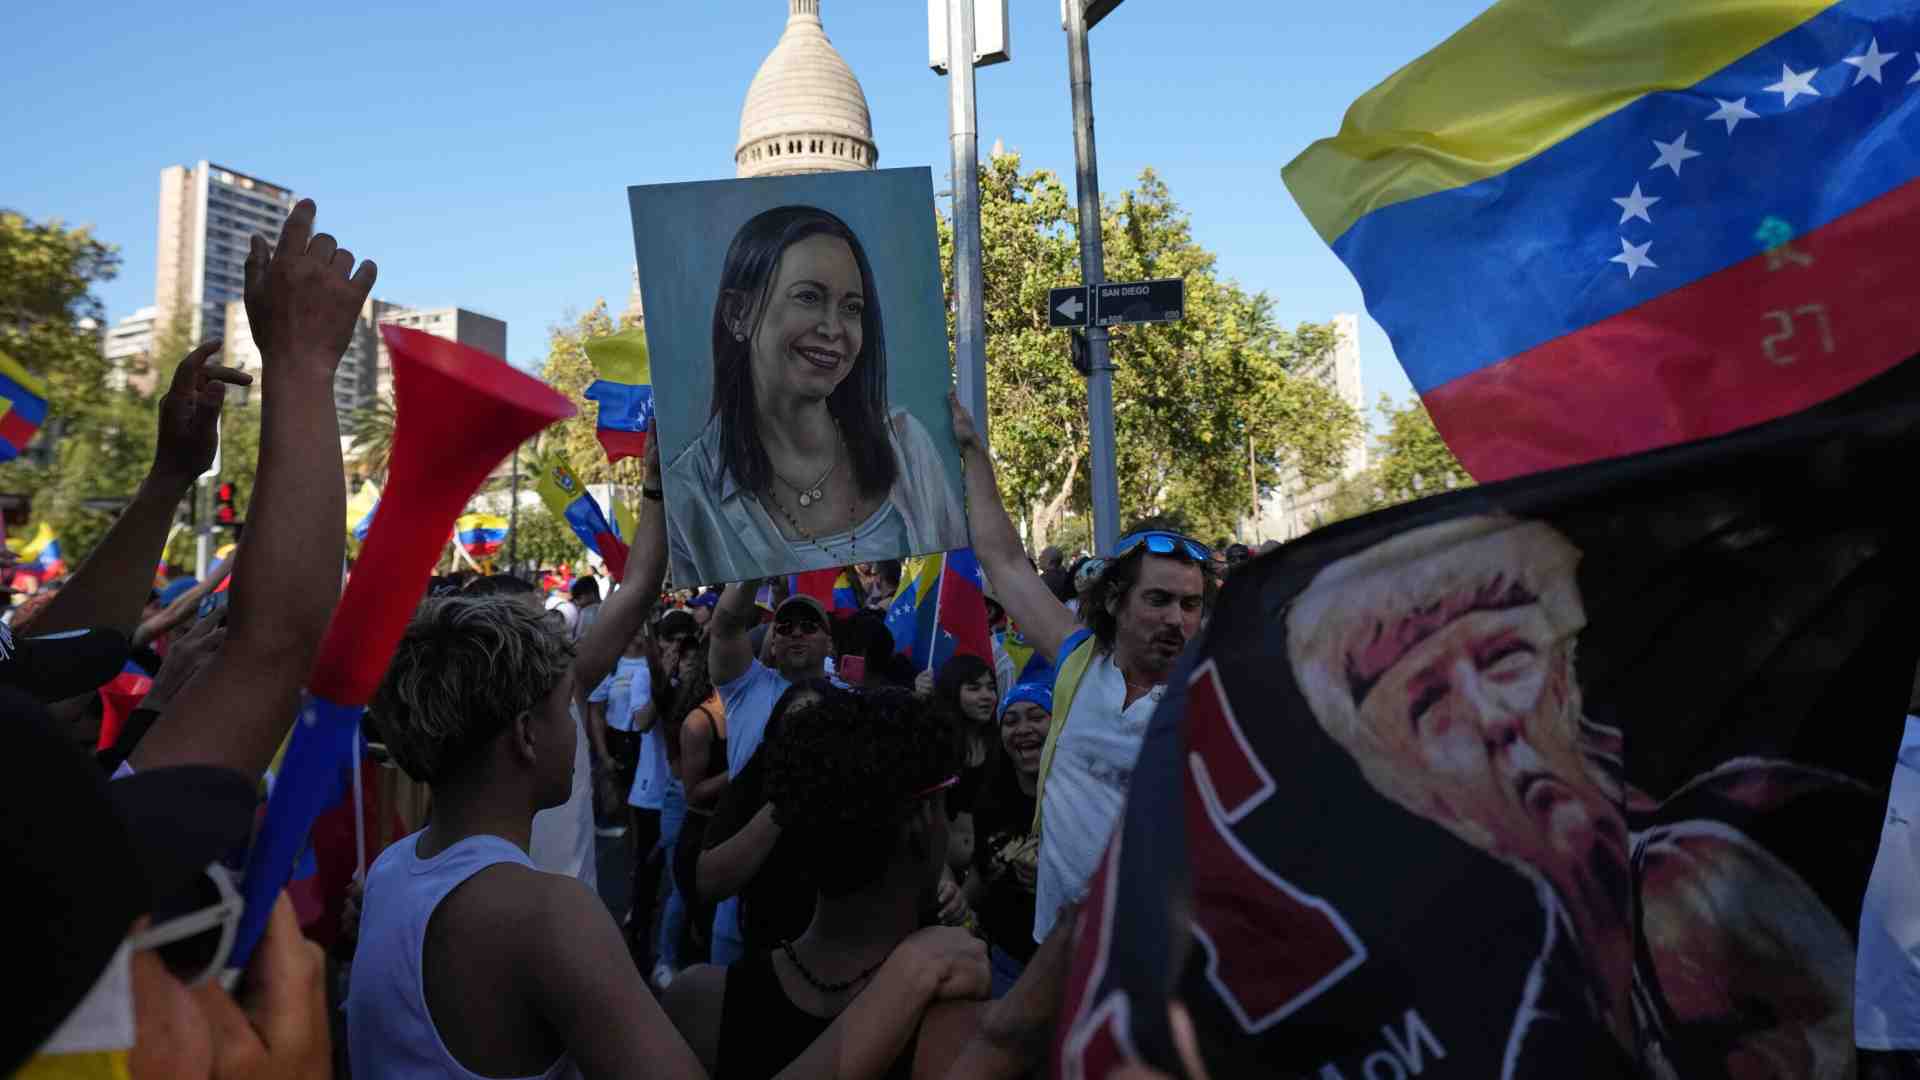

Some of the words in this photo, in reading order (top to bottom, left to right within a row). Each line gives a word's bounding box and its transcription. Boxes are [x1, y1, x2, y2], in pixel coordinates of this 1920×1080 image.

[1101, 288, 1120, 297] SAN
[1121, 286, 1150, 296] DIEGO
[1760, 303, 1835, 368] 27
